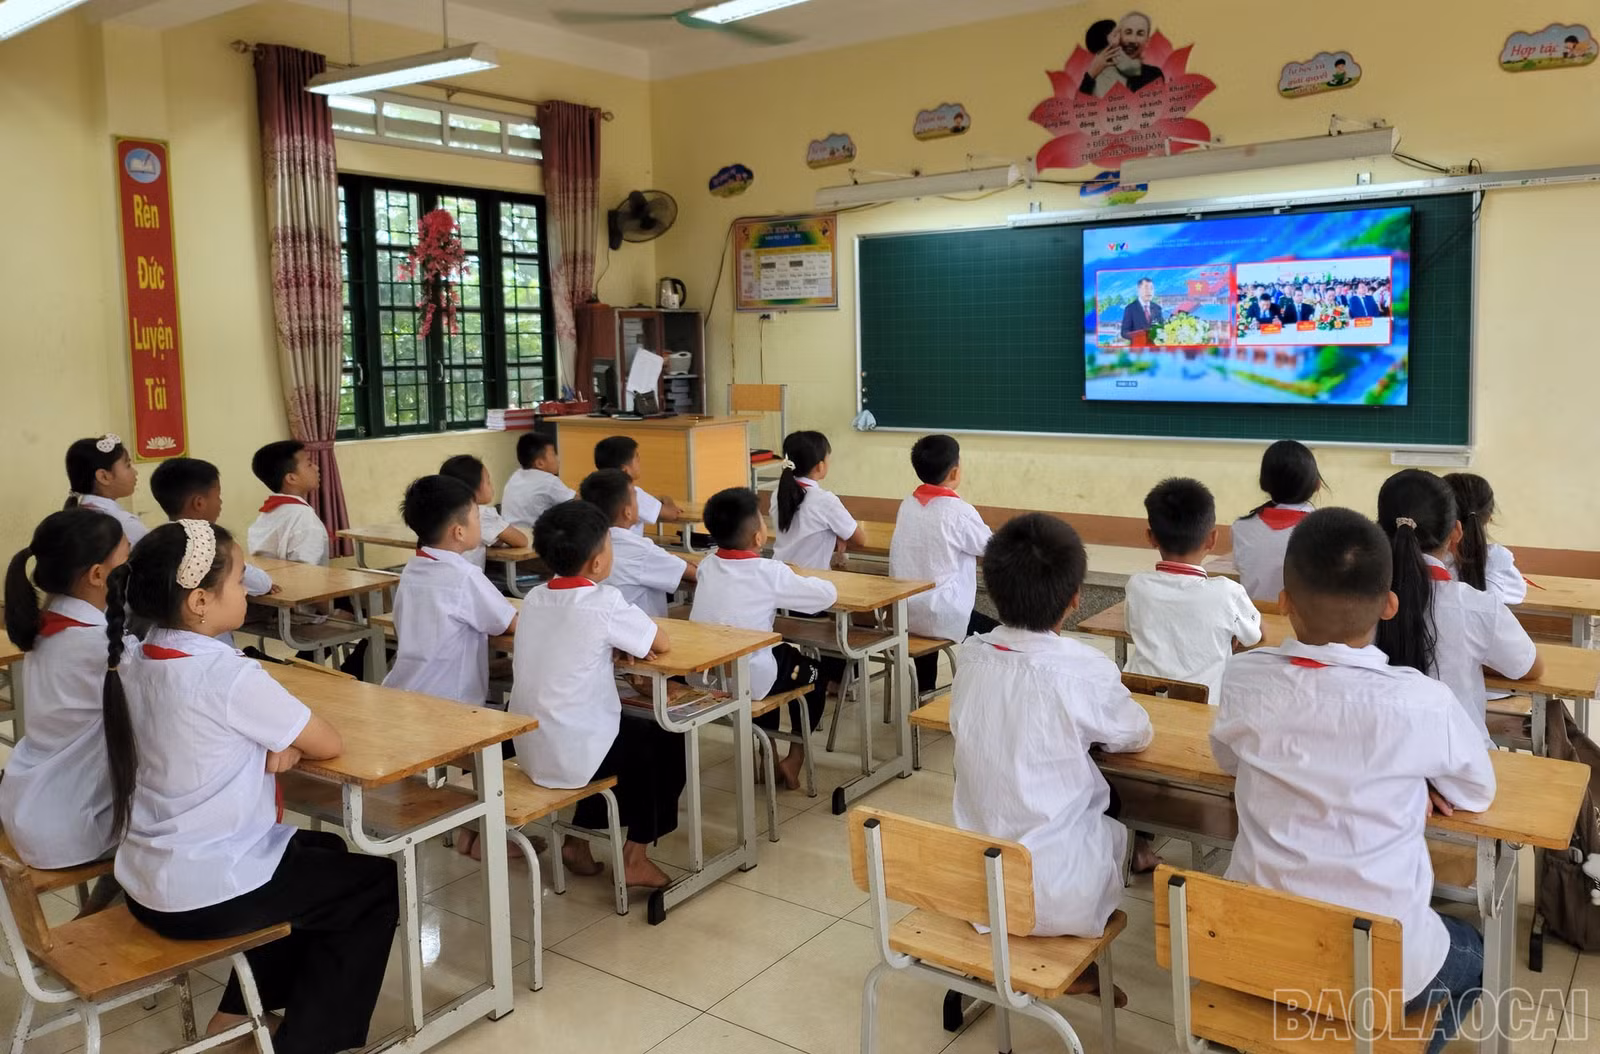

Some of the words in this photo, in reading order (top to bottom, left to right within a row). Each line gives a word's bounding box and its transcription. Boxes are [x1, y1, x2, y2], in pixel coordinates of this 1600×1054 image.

[1510, 44, 1536, 58] Hợp
[133, 195, 159, 229] Rèn
[137, 255, 164, 289] Đức
[133, 317, 173, 361] Luyện
[145, 378, 167, 411] Tài
